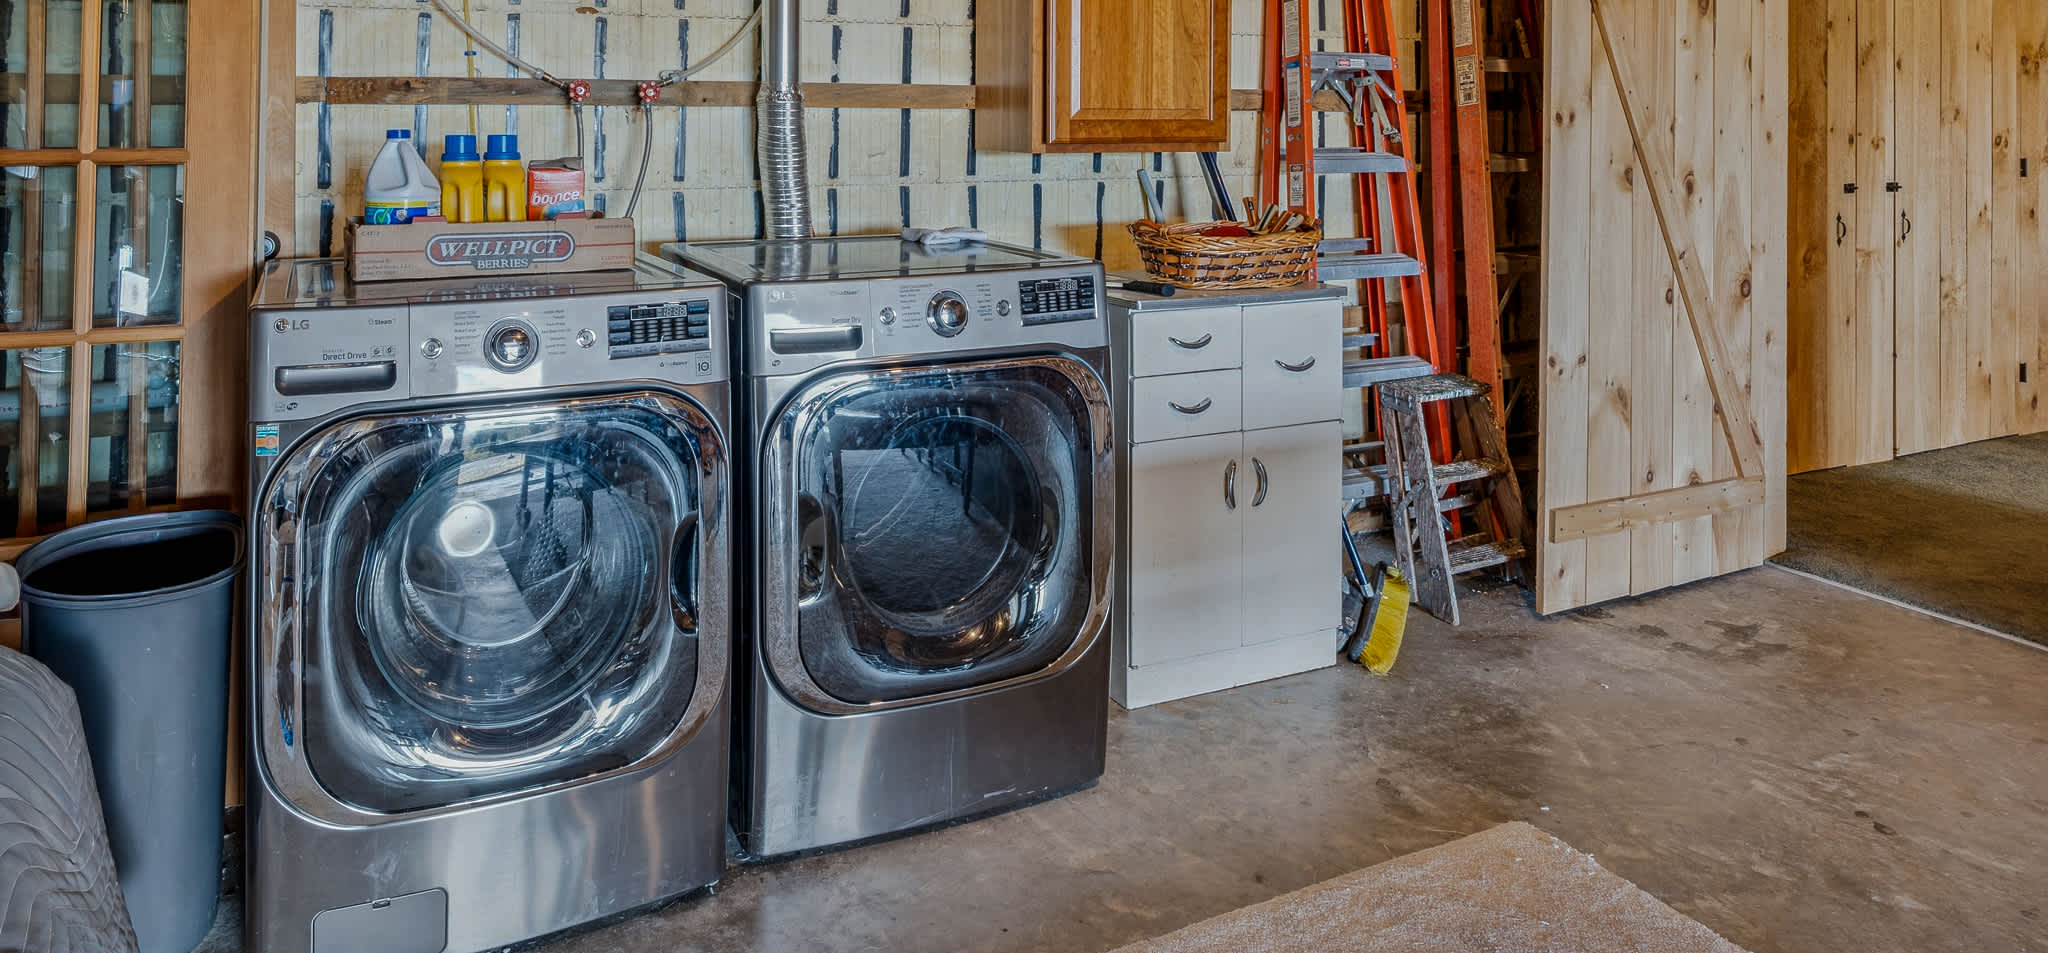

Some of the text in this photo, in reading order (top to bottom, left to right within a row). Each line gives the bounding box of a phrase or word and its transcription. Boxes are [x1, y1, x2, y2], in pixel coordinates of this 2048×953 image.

[531, 190, 580, 206] bounce
[477, 258, 529, 270] BERRIES
[292, 319, 310, 330] LG
[322, 353, 346, 361] Direct
[347, 351, 367, 360] Drive
